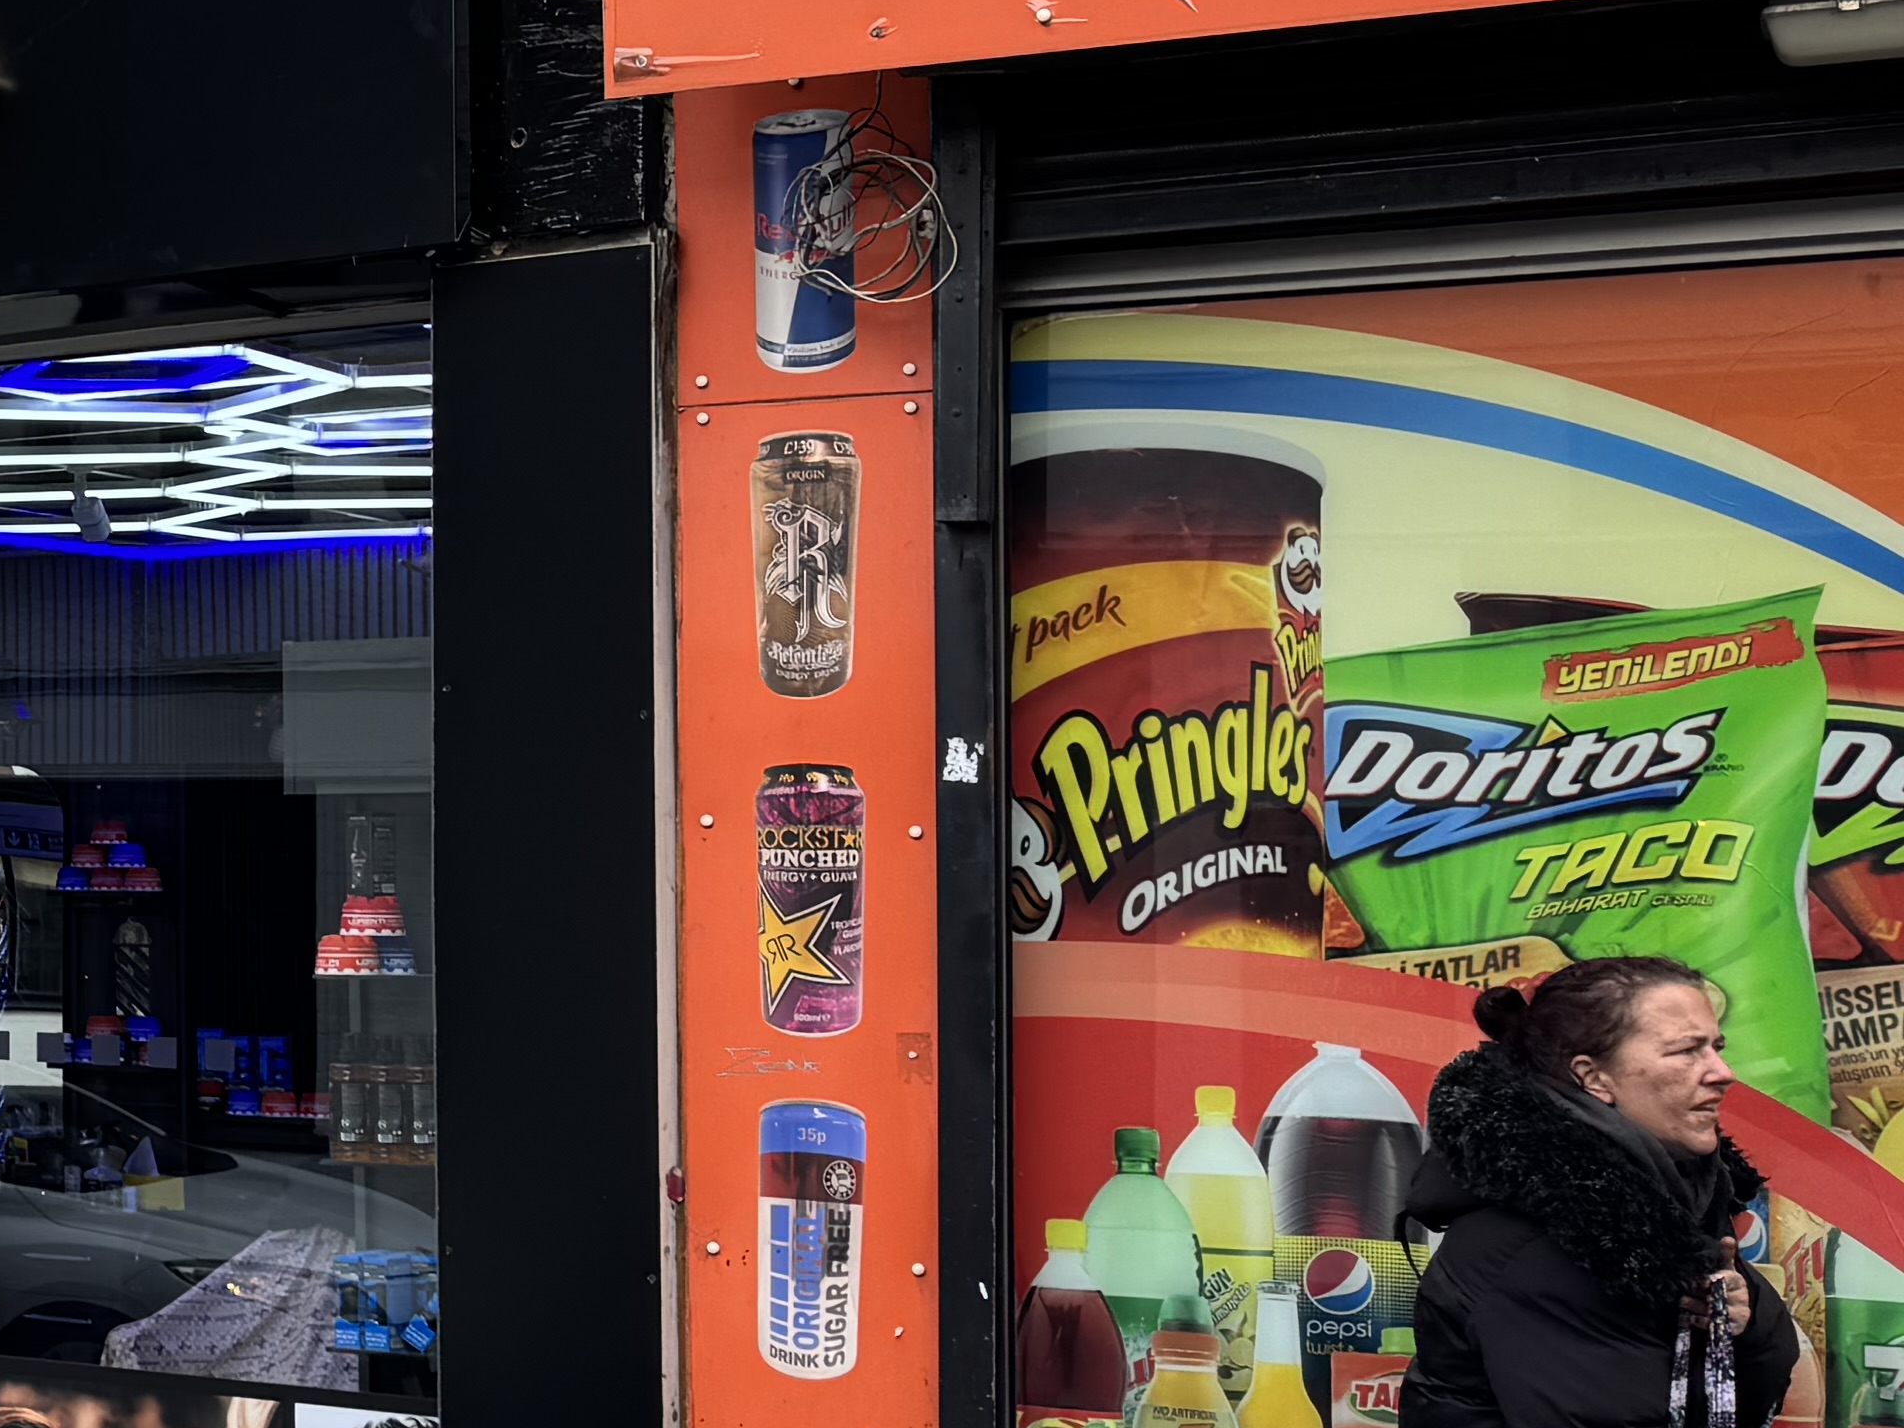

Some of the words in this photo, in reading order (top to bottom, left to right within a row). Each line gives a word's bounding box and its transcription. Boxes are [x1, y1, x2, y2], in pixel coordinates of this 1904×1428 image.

[785, 468, 826, 481] ORIGIN
[1025, 584, 1127, 664] pack
[1039, 669, 1312, 884] Pringles
[1325, 709, 1727, 804] Doritos
[760, 849, 860, 868] PUNCHED
[763, 870, 806, 884] ENERGY
[820, 870, 858, 883] GUAVA
[1509, 820, 1755, 900] TACO
[1121, 844, 1288, 932] ORIGINAL
[1526, 889, 1647, 921] BAHARAT
[796, 1127, 827, 1145] 35p
[826, 1202, 852, 1278] FREE
[824, 1282, 850, 1368] SUGAR
[1306, 1319, 1372, 1339] pepsi
[769, 1344, 820, 1369] DRINK
